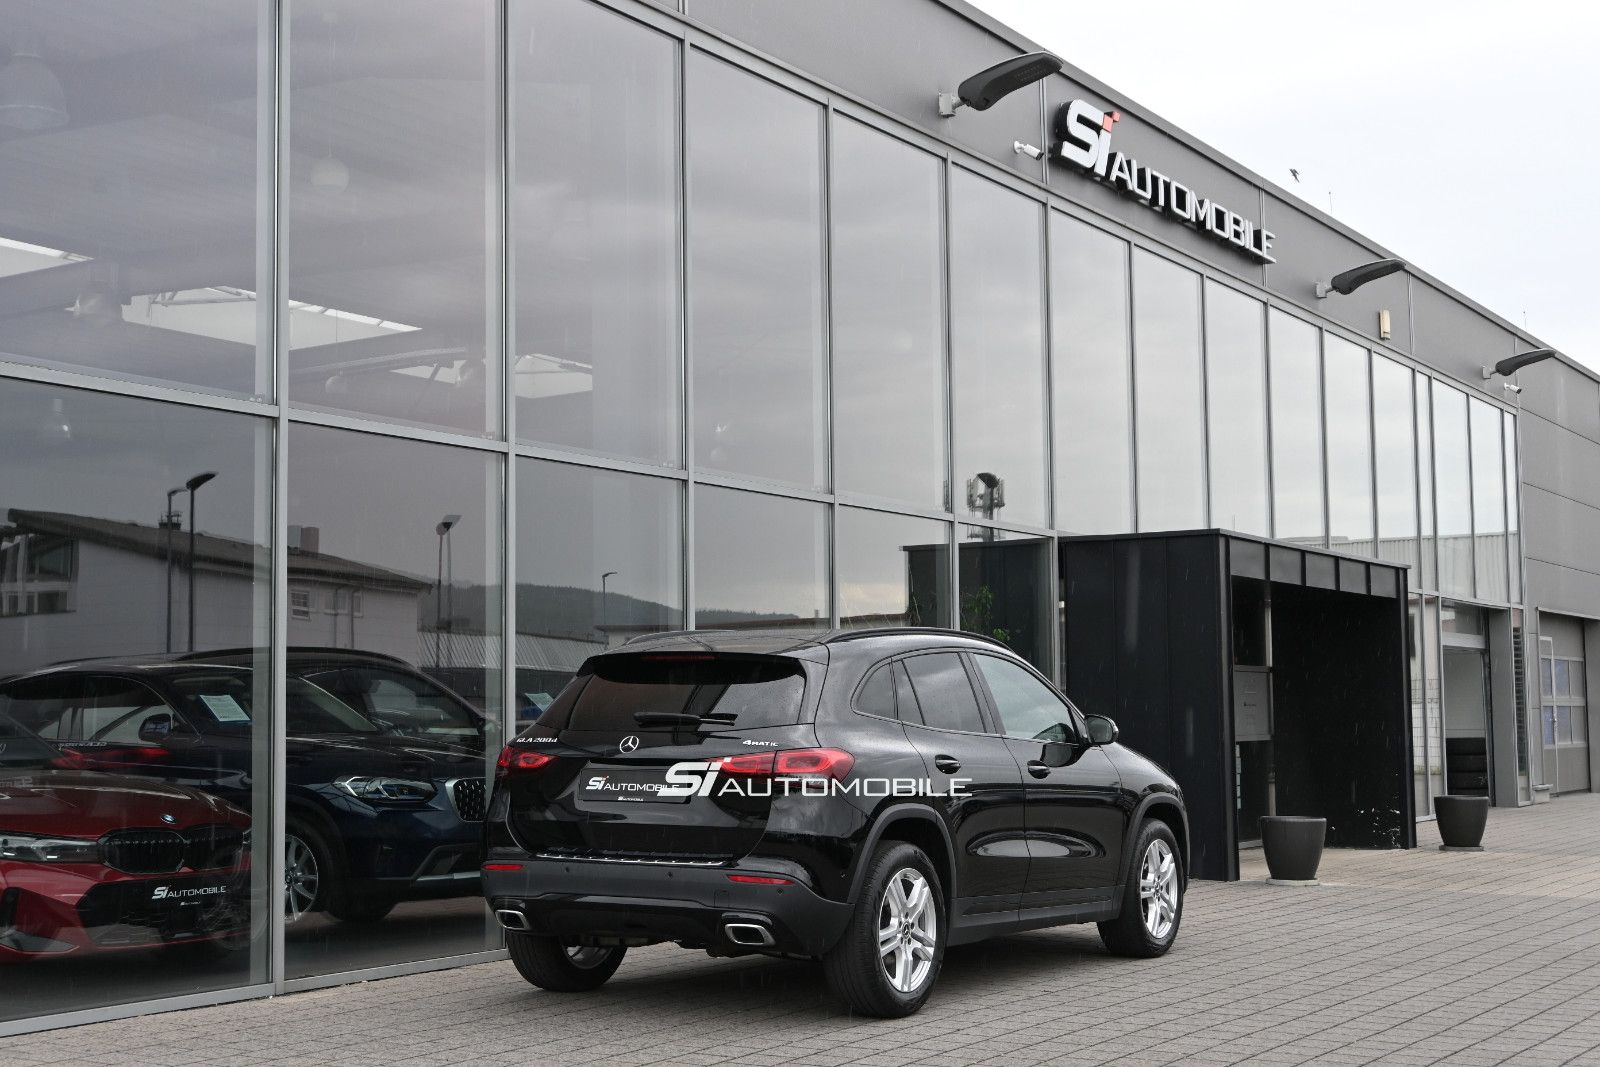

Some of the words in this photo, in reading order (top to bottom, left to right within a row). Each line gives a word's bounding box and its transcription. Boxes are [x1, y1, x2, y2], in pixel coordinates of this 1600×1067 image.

[1109, 152, 1277, 264] AUTOMOBILE
[742, 739, 779, 747] 4MATIC
[168, 886, 227, 898] AUTOMOBILE
